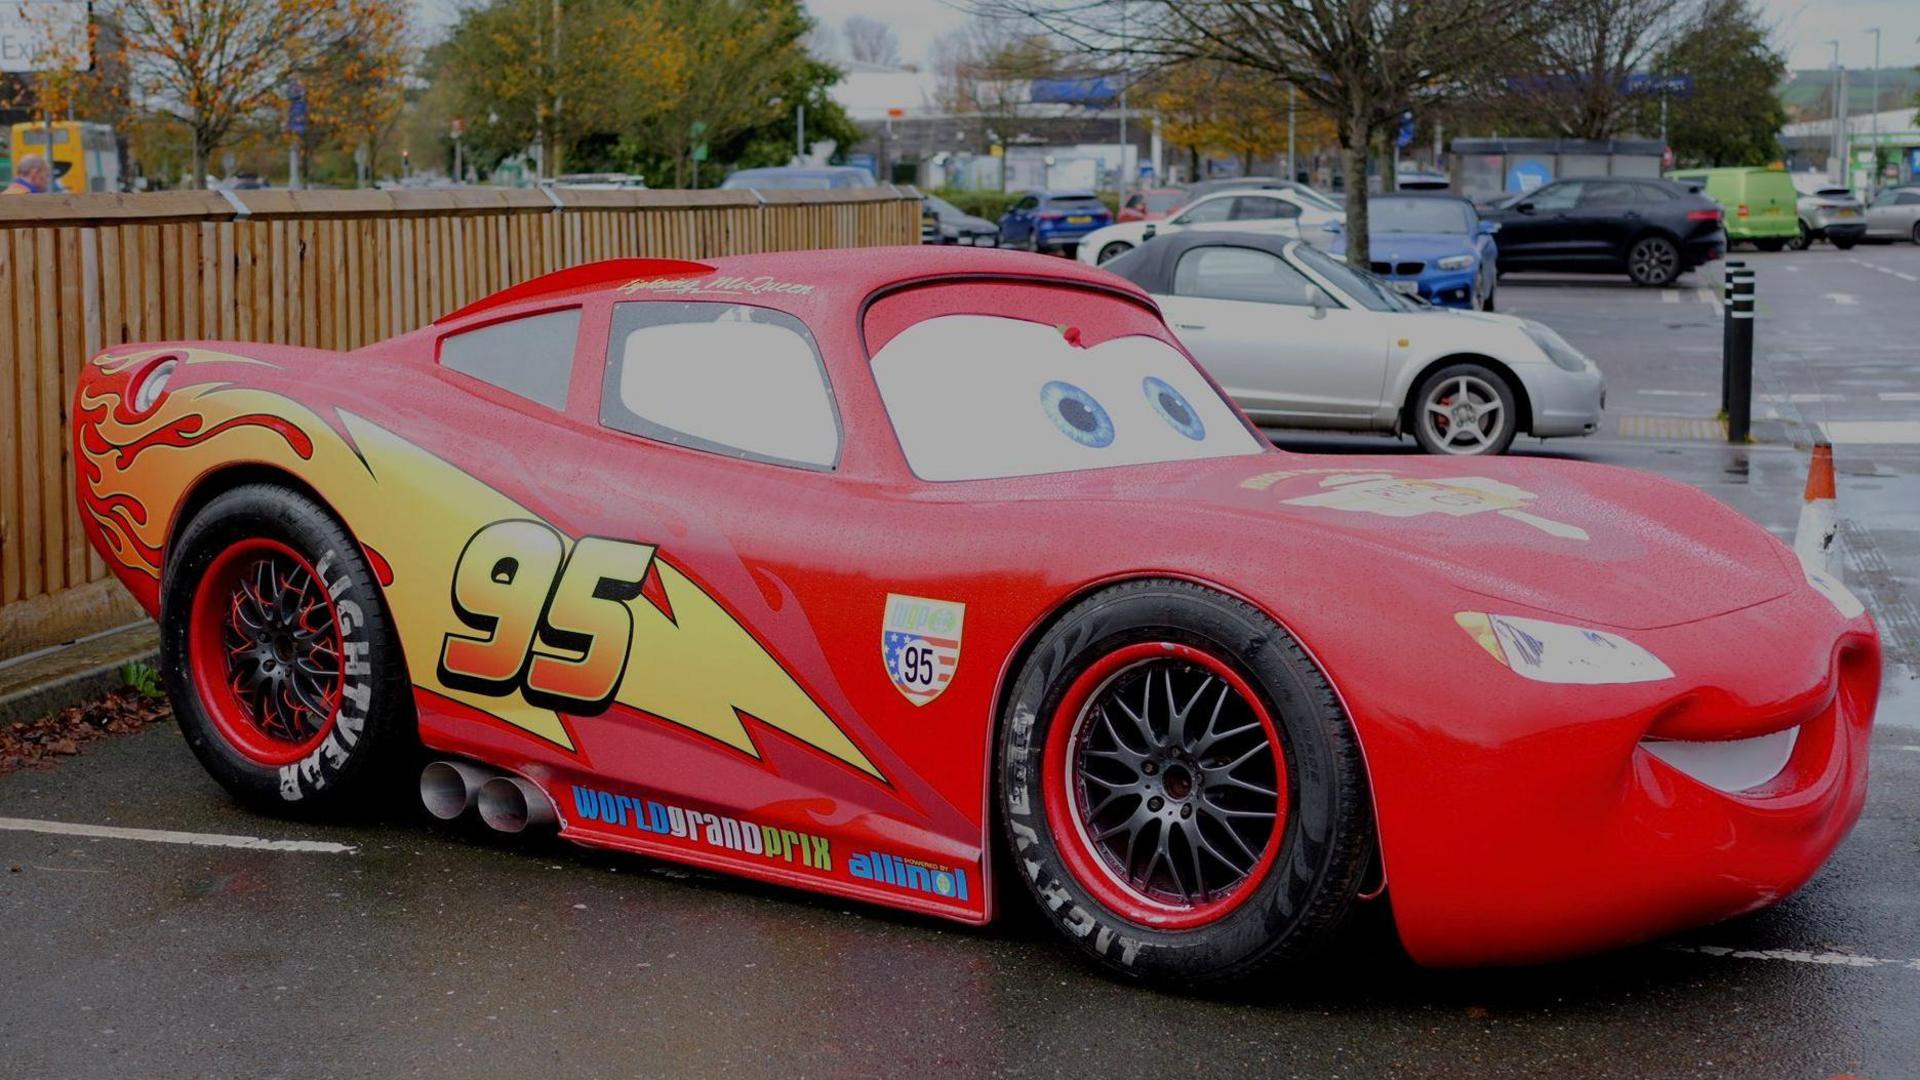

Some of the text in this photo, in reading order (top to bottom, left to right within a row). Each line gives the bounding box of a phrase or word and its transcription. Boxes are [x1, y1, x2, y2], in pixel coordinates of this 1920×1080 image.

[704, 276, 815, 295] McQueen
[436, 518, 660, 717] 95
[904, 646, 934, 686] 95
[848, 850, 969, 902] allinol
